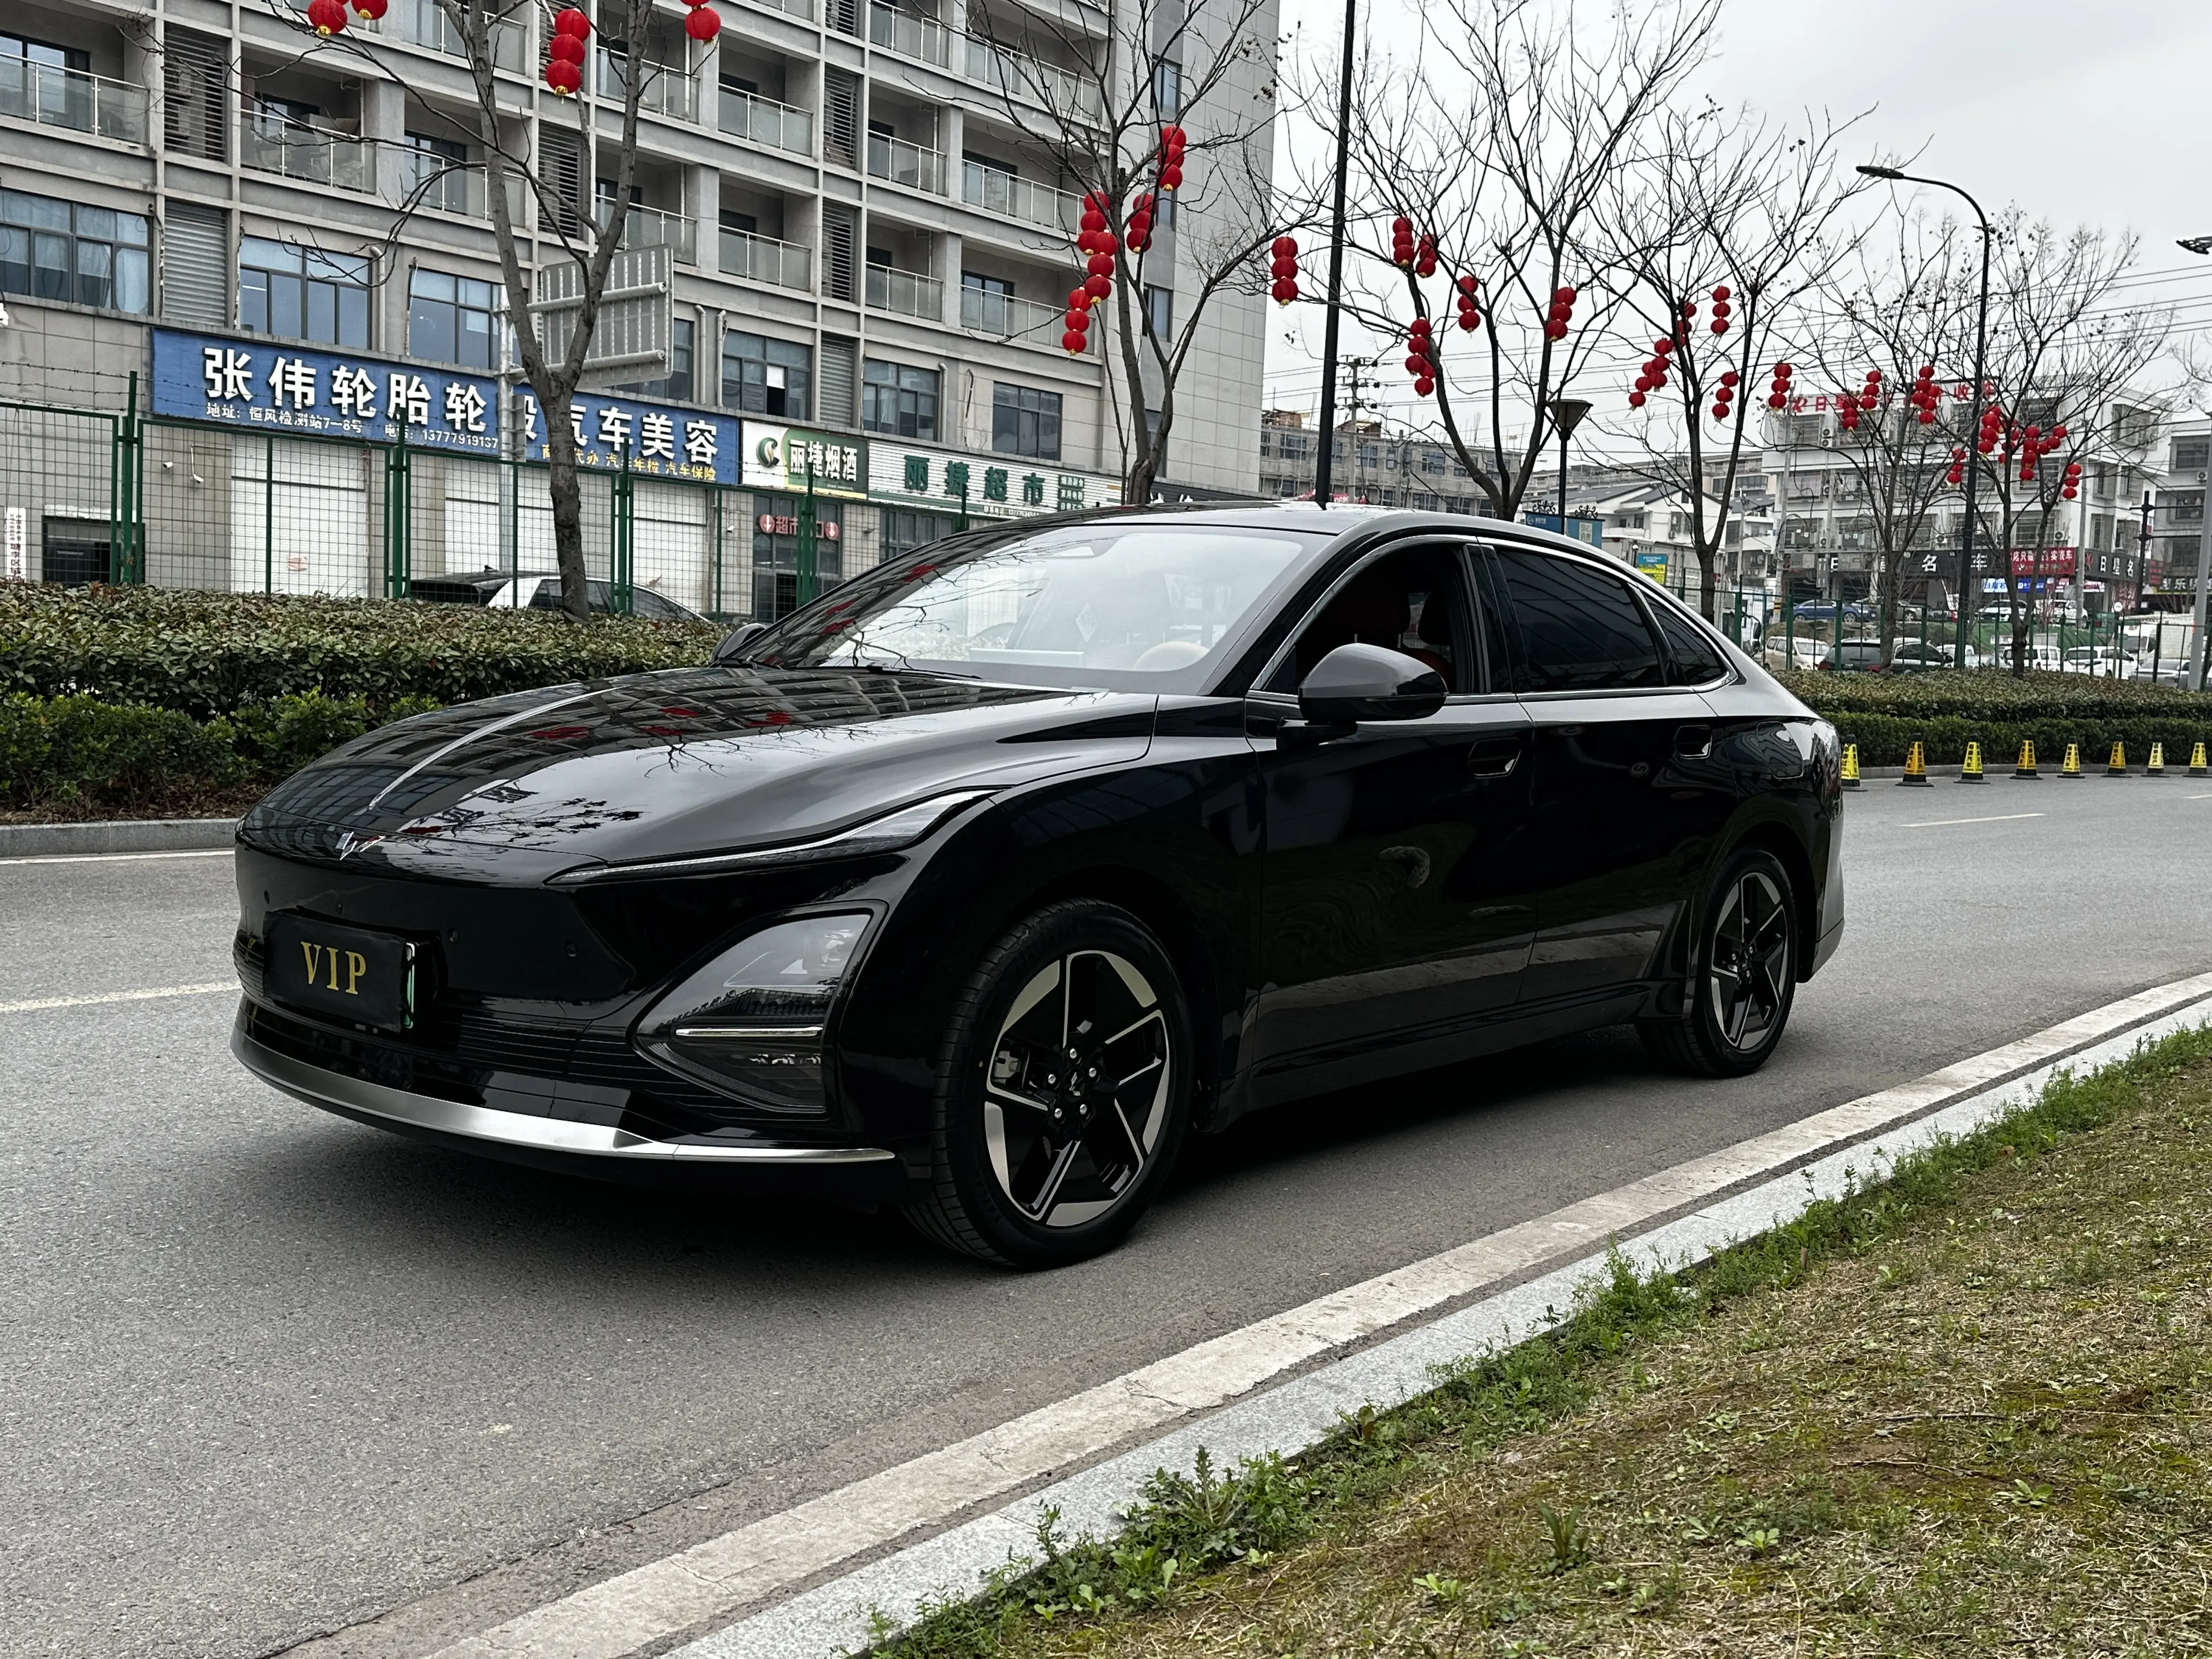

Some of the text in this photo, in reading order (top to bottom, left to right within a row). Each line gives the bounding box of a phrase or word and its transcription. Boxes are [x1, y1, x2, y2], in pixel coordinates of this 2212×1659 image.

[665, 462, 716, 481] 汽车保险
[789, 439, 857, 482] 丽捷烟酒
[776, 515, 825, 538] 超市口
[300, 941, 366, 995] VIP
